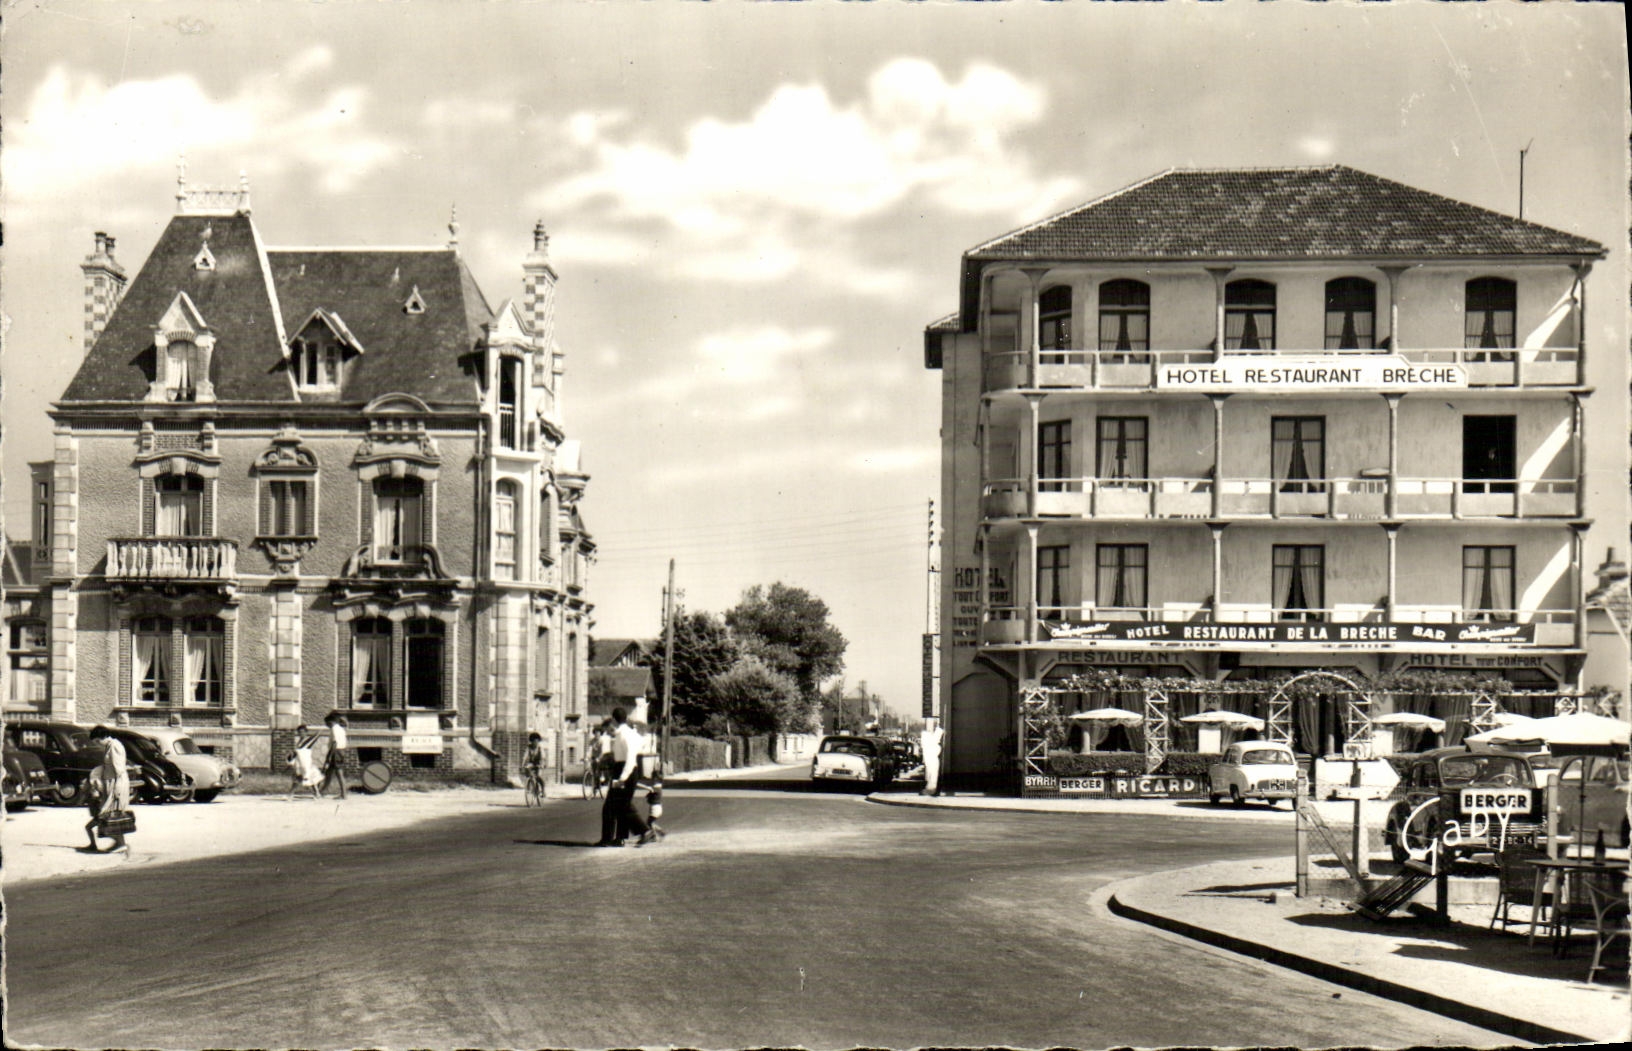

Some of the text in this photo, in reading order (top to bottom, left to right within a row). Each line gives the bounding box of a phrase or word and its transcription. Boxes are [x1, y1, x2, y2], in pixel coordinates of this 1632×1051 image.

[1167, 369, 1233, 384] HOTEL
[1245, 368, 1362, 383] RESTAURANT
[1126, 624, 1170, 639] HOTEL
[1183, 626, 1276, 640] RESTAURANT
[1286, 627, 1304, 640] DE
[1309, 627, 1329, 640] LA
[1411, 625, 1447, 641] BAR
[1058, 651, 1182, 665] RESTAURANT
[1410, 653, 1472, 666] HOTEL
[1498, 655, 1543, 666] CONFORT
[1025, 775, 1057, 787] BYRRH
[1061, 780, 1102, 789] BERGER
[1116, 777, 1196, 794] RICARD
[1464, 794, 1527, 809] BERGER
